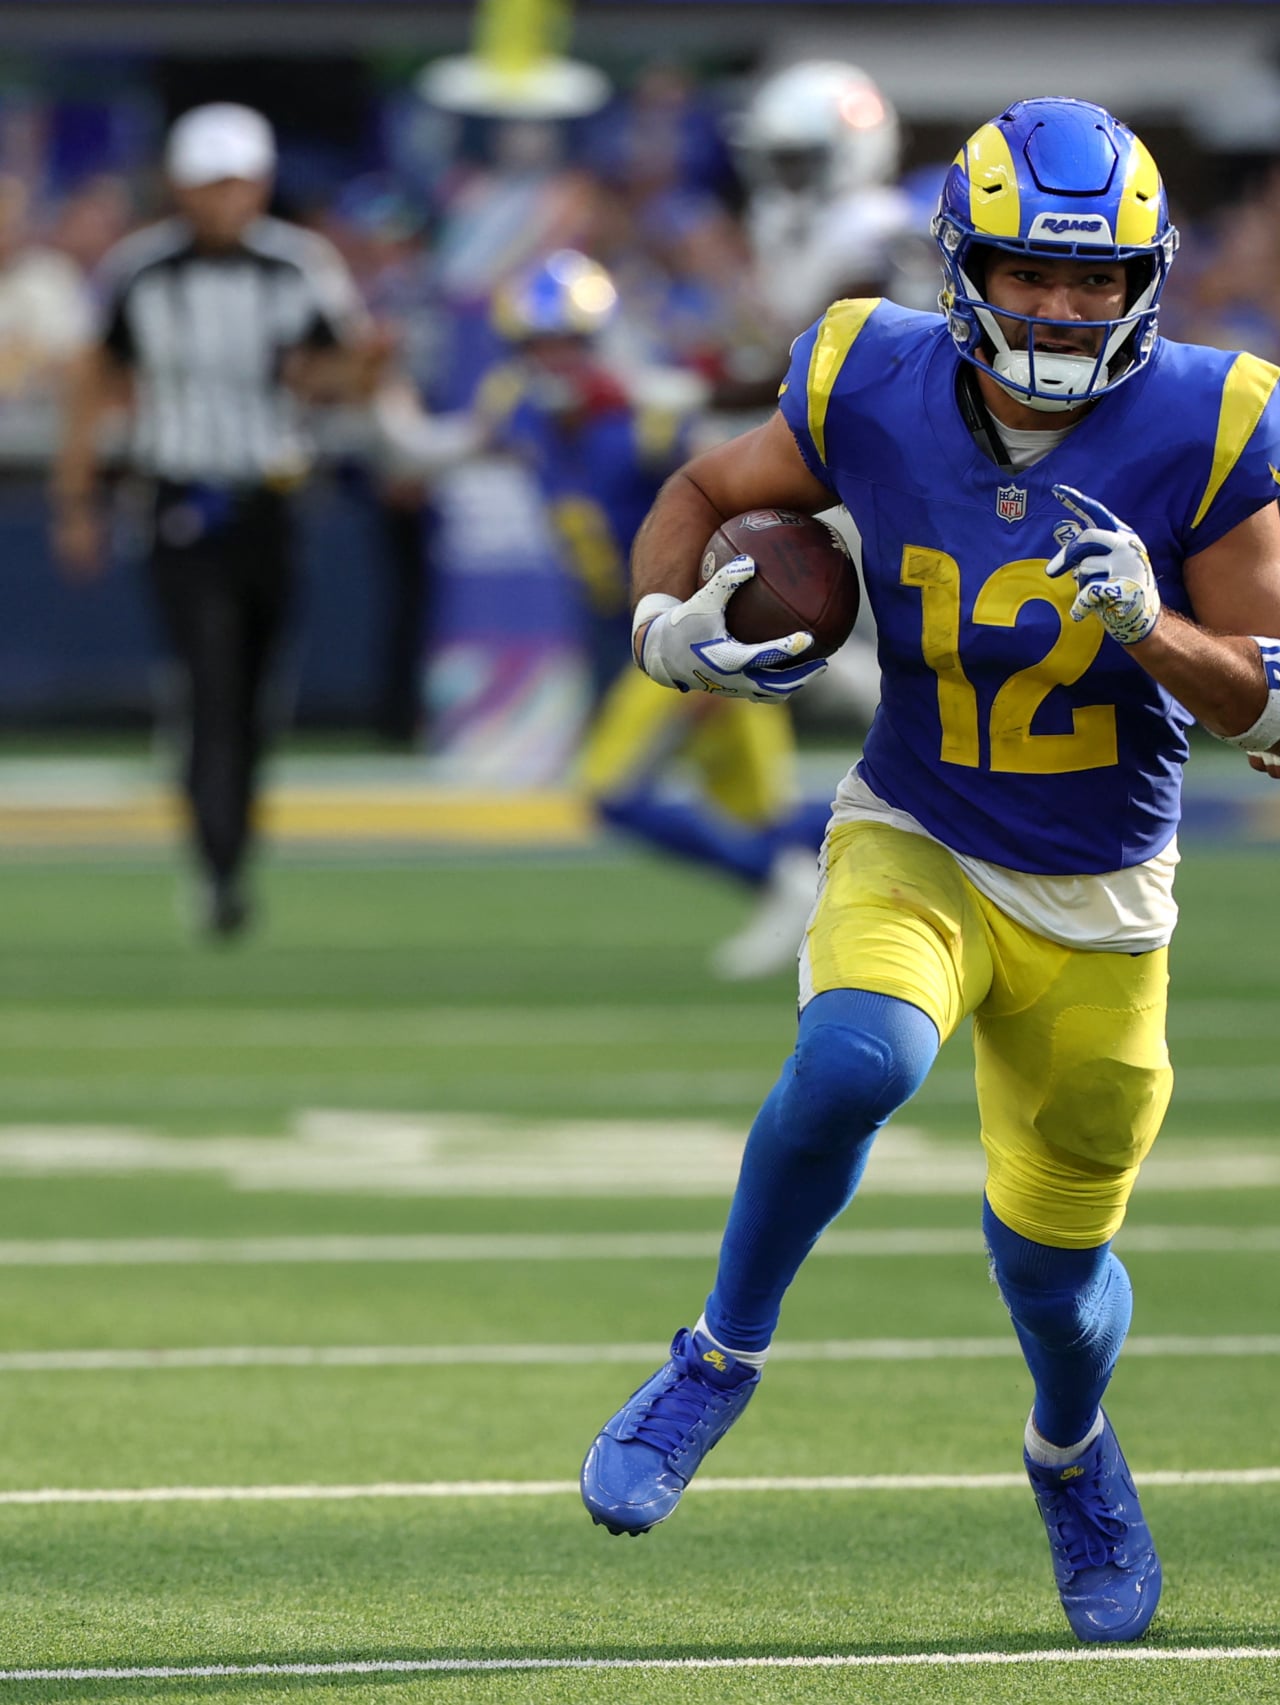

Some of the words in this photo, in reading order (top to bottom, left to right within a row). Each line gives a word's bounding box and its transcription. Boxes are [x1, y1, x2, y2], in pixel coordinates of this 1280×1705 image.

[1041, 218, 1103, 234] RAMS
[1001, 501, 1021, 516] NFL
[1057, 526, 1077, 543] 12
[901, 544, 1119, 775] 12
